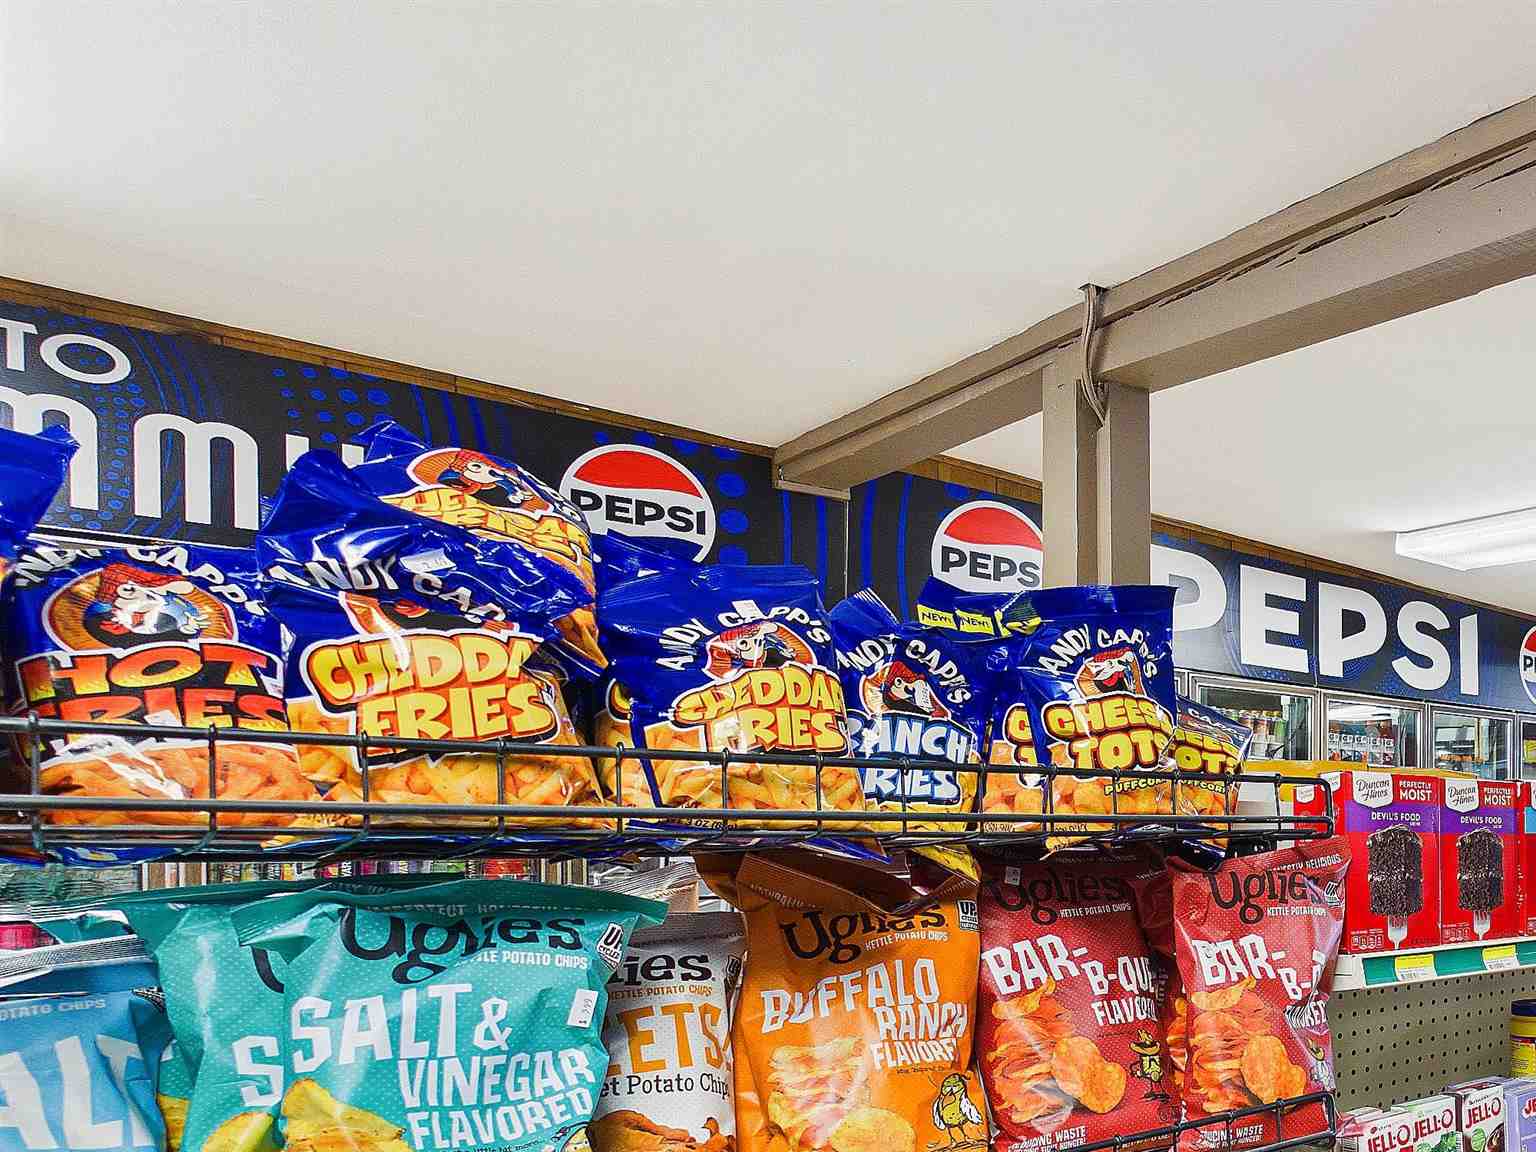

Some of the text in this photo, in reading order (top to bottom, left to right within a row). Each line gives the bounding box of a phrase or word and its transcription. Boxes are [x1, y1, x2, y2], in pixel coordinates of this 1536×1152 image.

[0, 318, 132, 384] TO
[570, 488, 706, 536] PEPSI
[940, 545, 1040, 590] PEPS
[921, 611, 991, 630] NEW! NEW!
[1151, 543, 1479, 696] PEPSI
[656, 617, 715, 672] ANDY
[1038, 623, 1091, 677] ANDY
[20, 641, 268, 702] HOT
[907, 638, 973, 705] CAPP'S
[357, 677, 556, 757] FRIES
[1356, 778, 1391, 801] Duncan Hines
[1399, 781, 1432, 792] PERFECTLY
[1399, 789, 1432, 802] MOIST
[1447, 784, 1476, 805] Duncan Hines
[1483, 787, 1511, 797] PERFECTLY
[1484, 795, 1512, 807] MOIST
[1371, 812, 1421, 823] DEVIL'S FOOD
[1460, 816, 1503, 826] DEVIL'S FOOD
[1060, 901, 1132, 918] KETTLE POTATO CHIPS
[1267, 907, 1289, 917] KETTLE
[502, 952, 588, 970] POTATO CHIPS
[981, 934, 1090, 997] BAR-
[1190, 934, 1287, 986] BAR-
[645, 984, 713, 998] POTATO CHIPS
[759, 957, 941, 1037] BUFFALO
[291, 983, 513, 1074] SALT &
[873, 1002, 970, 1042] RANCH
[397, 1047, 596, 1109] VINEGAR
[627, 1072, 695, 1095] Potato
[406, 1087, 593, 1151] FLAVORED
[1413, 1108, 1454, 1144] JELL-O
[1465, 1096, 1502, 1130] JELL-O
[1053, 1126, 1086, 1143] WASTE
